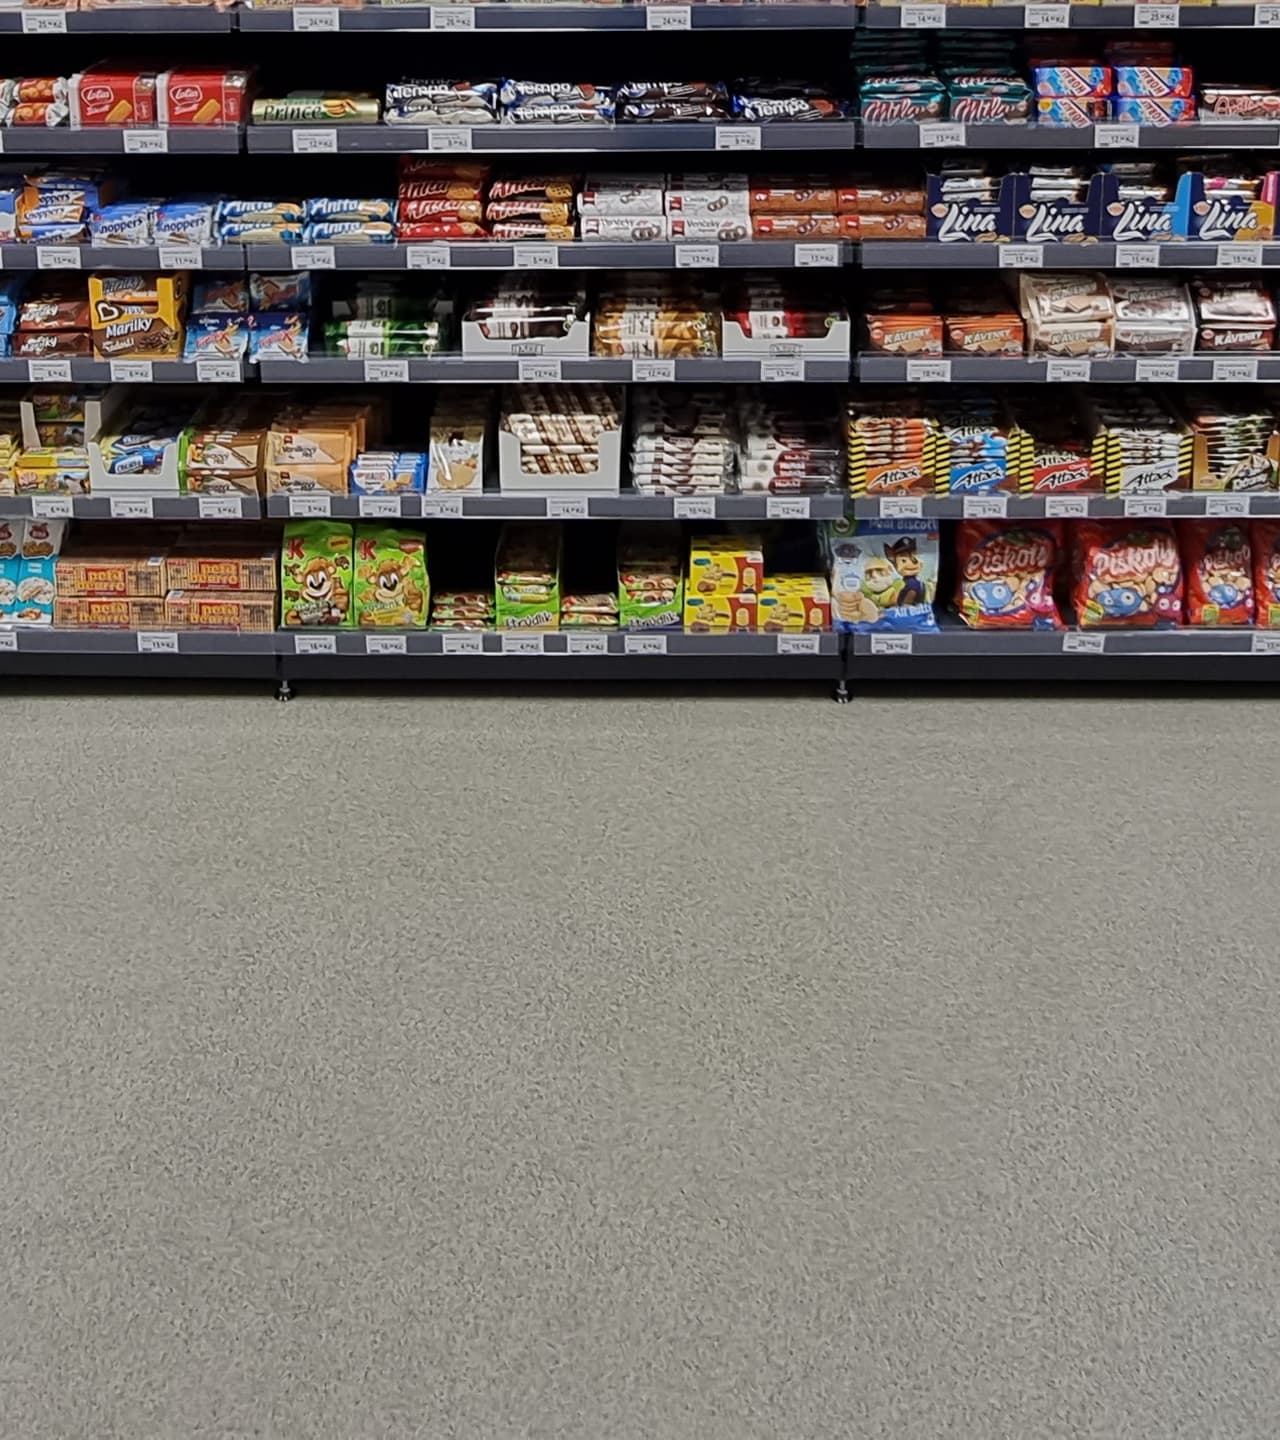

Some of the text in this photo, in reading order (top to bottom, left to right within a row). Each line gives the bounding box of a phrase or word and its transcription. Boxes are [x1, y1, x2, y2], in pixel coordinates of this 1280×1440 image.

[263, 103, 322, 121] Prince
[937, 201, 996, 241] Lina
[1026, 203, 1085, 241] Lina
[1112, 203, 1173, 241] Lina
[1198, 200, 1258, 240] Lina
[106, 318, 152, 338] Marilky
